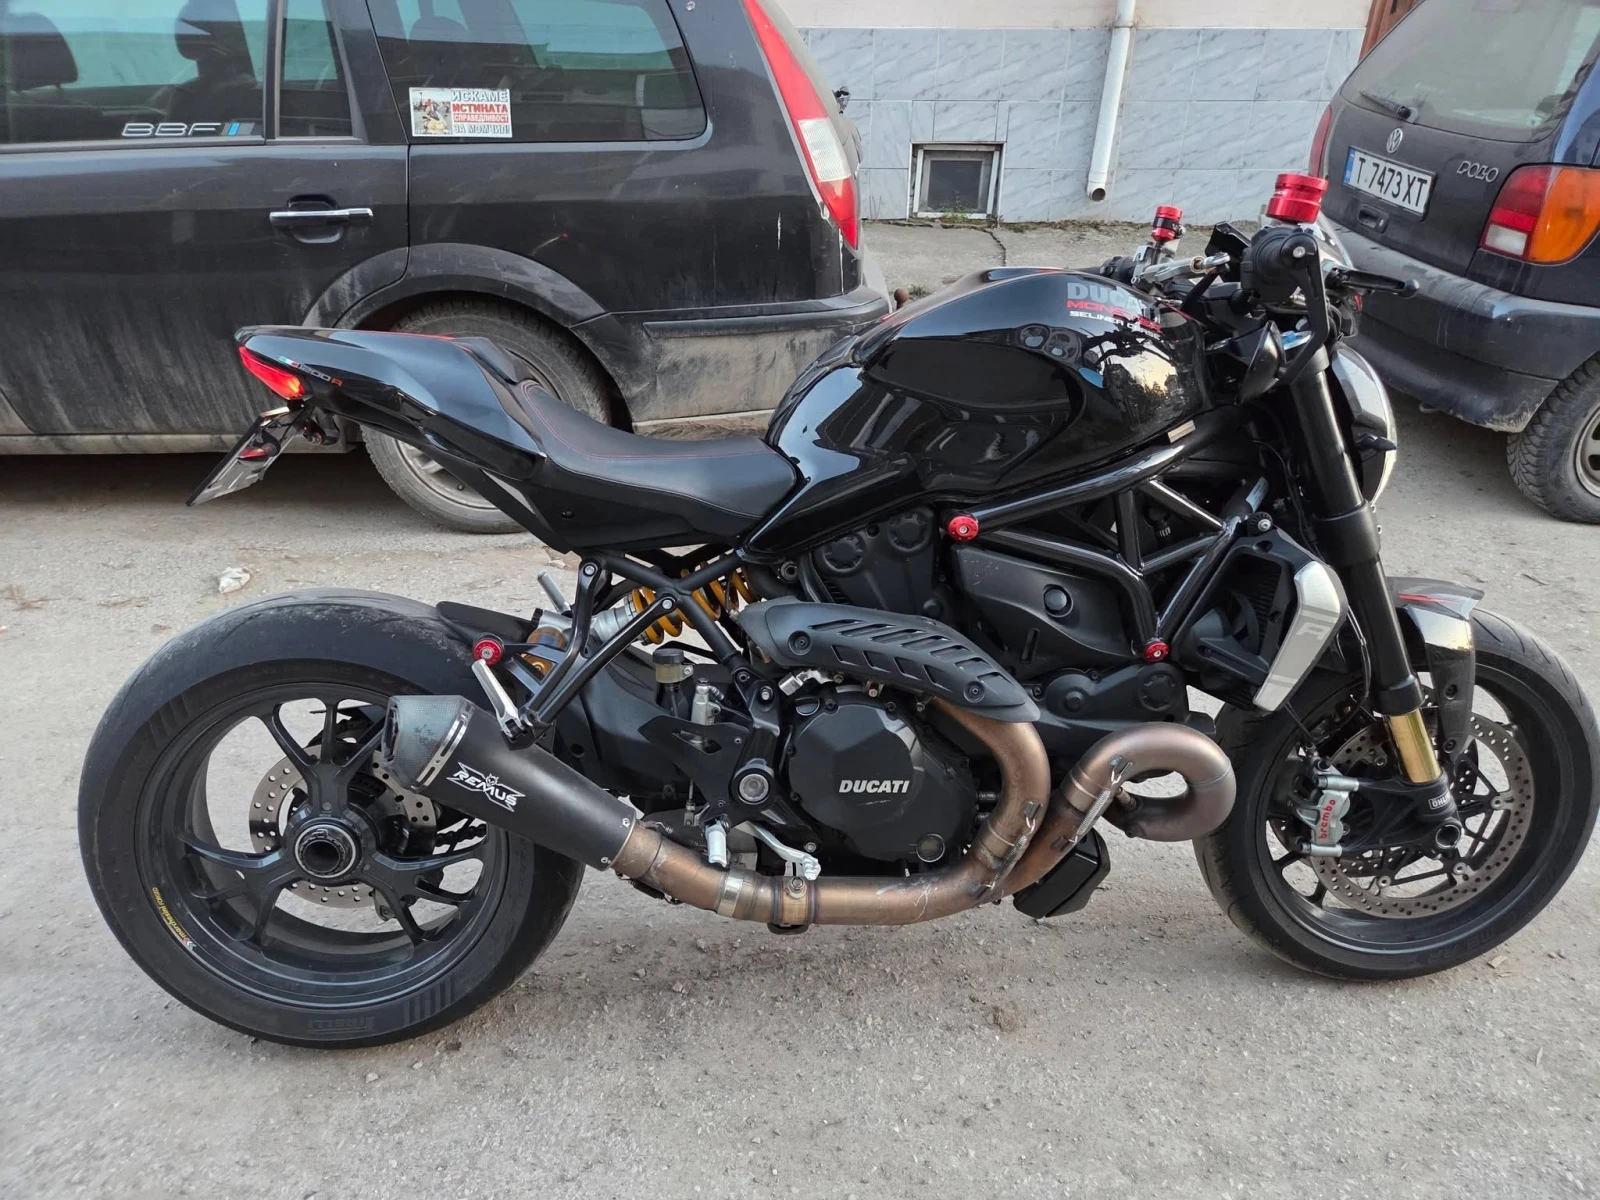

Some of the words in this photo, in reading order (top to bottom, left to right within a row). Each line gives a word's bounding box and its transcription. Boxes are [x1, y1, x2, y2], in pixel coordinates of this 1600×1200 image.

[451, 90, 508, 103] ИСКАМЕ
[452, 103, 508, 113] ИСТИНАТА
[121, 122, 222, 137] BBF
[454, 124, 466, 134] ЗА
[1356, 157, 1366, 185] T
[1368, 162, 1403, 199] 7473
[1456, 160, 1499, 183] POLO
[299, 363, 331, 382] 1200
[453, 770, 518, 807] REMUS
[838, 779, 910, 794] DUCATI
[1318, 799, 1336, 839] brembo
